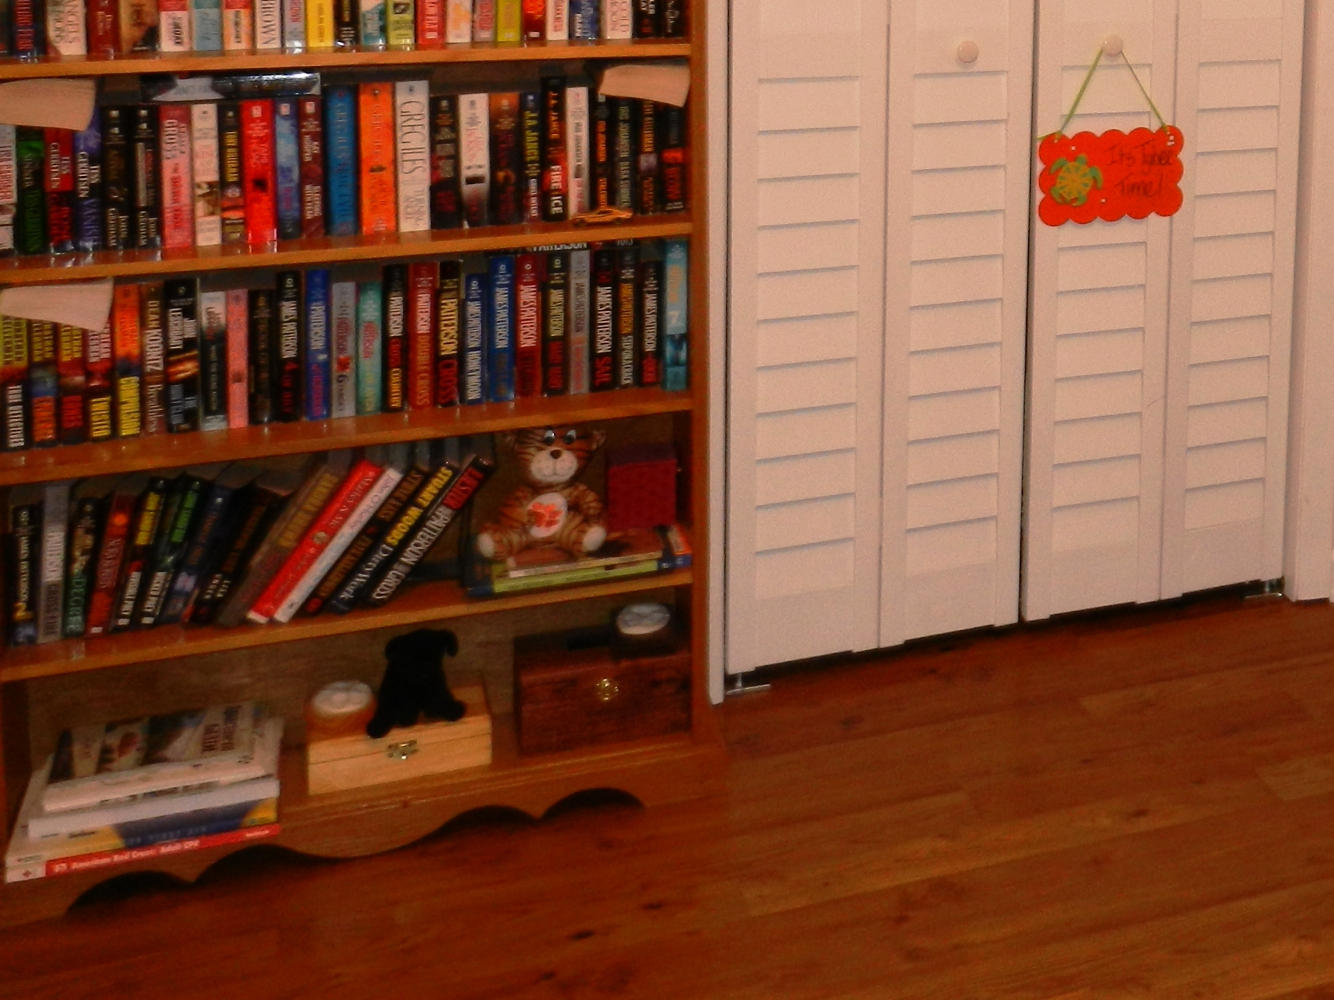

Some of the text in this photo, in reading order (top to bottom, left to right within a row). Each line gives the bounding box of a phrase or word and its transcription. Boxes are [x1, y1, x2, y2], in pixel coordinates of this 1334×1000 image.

[549, 91, 561, 139] J.A. JANCE
[164, 119, 179, 160] GROSS
[303, 135, 313, 162] HOOPER
[311, 141, 321, 154] KAY
[400, 100, 427, 175] GREG ILES
[524, 110, 540, 162] J.A. JANCE
[49, 142, 60, 189] GERRITSEN
[60, 156, 71, 174] TESS
[77, 151, 89, 198] GERRITSEN
[89, 164, 102, 184] TESS
[304, 183, 313, 202] WITH
[311, 185, 322, 217] SLEEPING
[550, 164, 564, 215] FIRE ICE
[106, 207, 119, 247] GRISHAM
[118, 215, 130, 238] JOHN
[136, 210, 148, 246] GRISHAM
[148, 217, 158, 238] JOHN
[494, 286, 509, 308] JAMES
[519, 284, 537, 307] JAMES
[549, 288, 564, 306] JAMES
[643, 292, 658, 314] JAMES
[144, 300, 164, 373] DEAN KOONTZ
[168, 307, 185, 350] LESCROART
[280, 300, 298, 359] JAMES PATTERSON
[310, 305, 327, 350] PATTERSON
[388, 296, 404, 337] PATTERSON
[466, 318, 482, 348] PATTERSON
[495, 308, 510, 349] PATTERSON
[519, 307, 538, 348] PATTERSON
[549, 305, 565, 337] PATTERSON
[594, 285, 613, 386] JAMES PATTERSON SAIL
[644, 314, 658, 352] PATTERSON
[415, 293, 432, 406] PATTERSON DOUBLE CROSS
[438, 298, 459, 405] PATTERSON CROSS
[620, 335, 634, 349] STEP
[390, 367, 403, 408] COUNTRY
[466, 350, 483, 400] HONEYMOON
[620, 364, 634, 385] CRACK
[7, 384, 26, 448] TRUE DETECTIVES
[90, 395, 112, 438] TWISTED
[119, 375, 141, 437] COMPULSION
[147, 383, 164, 433] Breathless
[385, 465, 453, 546] STUART WOODS
[45, 531, 65, 582] PATTERSON
[340, 543, 394, 601] Dirty Work
[371, 507, 450, 600] PATTERSON GROSS
[17, 560, 30, 602] PATTERSON
[66, 577, 86, 633] DEGREE
[72, 856, 112, 870] American
[113, 851, 131, 862] Red
